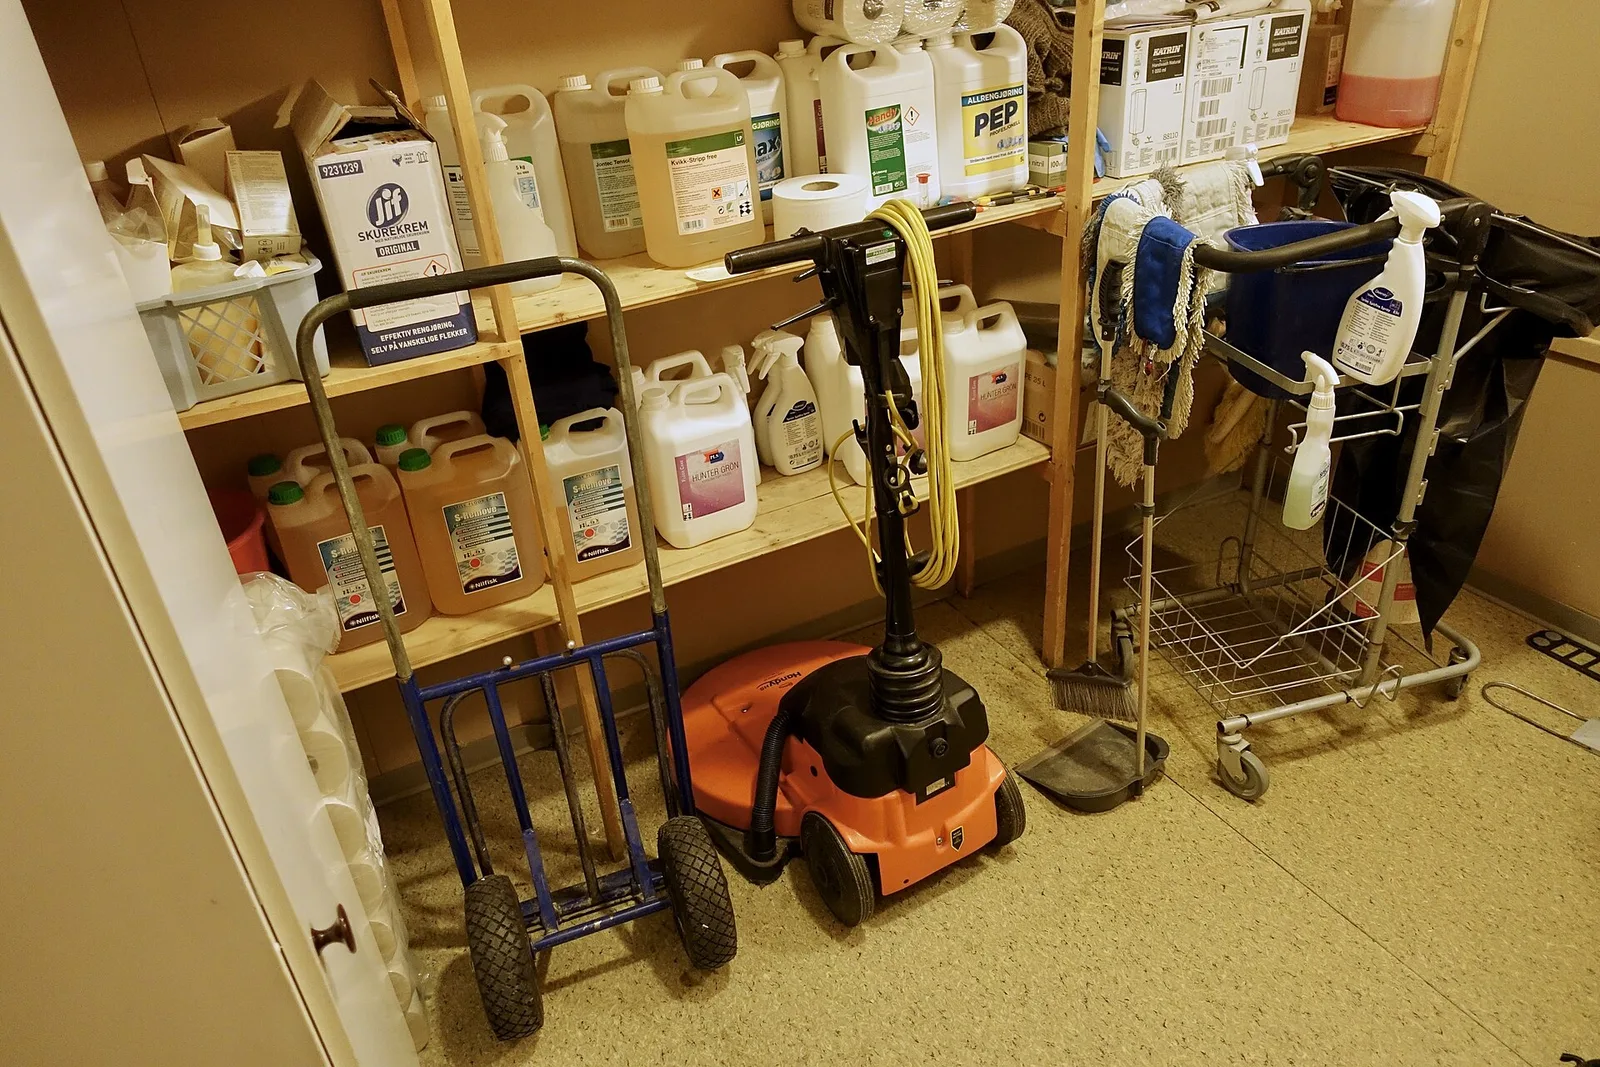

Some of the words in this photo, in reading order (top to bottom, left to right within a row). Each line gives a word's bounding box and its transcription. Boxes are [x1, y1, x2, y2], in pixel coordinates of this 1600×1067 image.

[1274, 26, 1299, 37] KATRIN
[1102, 51, 1120, 60] TRIN
[1153, 44, 1183, 57] KATRIN
[967, 87, 1023, 104] ALLRENGJØRING
[752, 118, 780, 130] GJØRING
[974, 100, 1018, 137] PEP
[989, 120, 1021, 137] PROFESJONELL
[1163, 131, 1178, 141] 88110
[596, 160, 613, 168] Jontec
[670, 155, 706, 166] Kvikk-Stripp
[322, 162, 359, 177] 9231239
[374, 188, 402, 226] Jif
[358, 221, 429, 242] SKUREKREM
[379, 242, 417, 256] ORIGINAL
[380, 329, 412, 342] EFFEKTIV
[412, 321, 455, 335] RENGJØRING,
[371, 345, 389, 354] SELV
[389, 341, 399, 351] PÅ
[398, 335, 439, 349] VANSKELIGE
[439, 327, 468, 340] FLEKKER
[980, 388, 1002, 401] HUNTER
[692, 467, 719, 482] HUNTER
[572, 478, 612, 494] S-Remove
[454, 505, 498, 522] S-Remove
[588, 547, 610, 557] Nilfisk
[474, 578, 498, 589] Nilfisk
[356, 613, 380, 625] Nilfisk
[769, 671, 802, 687] Handy
